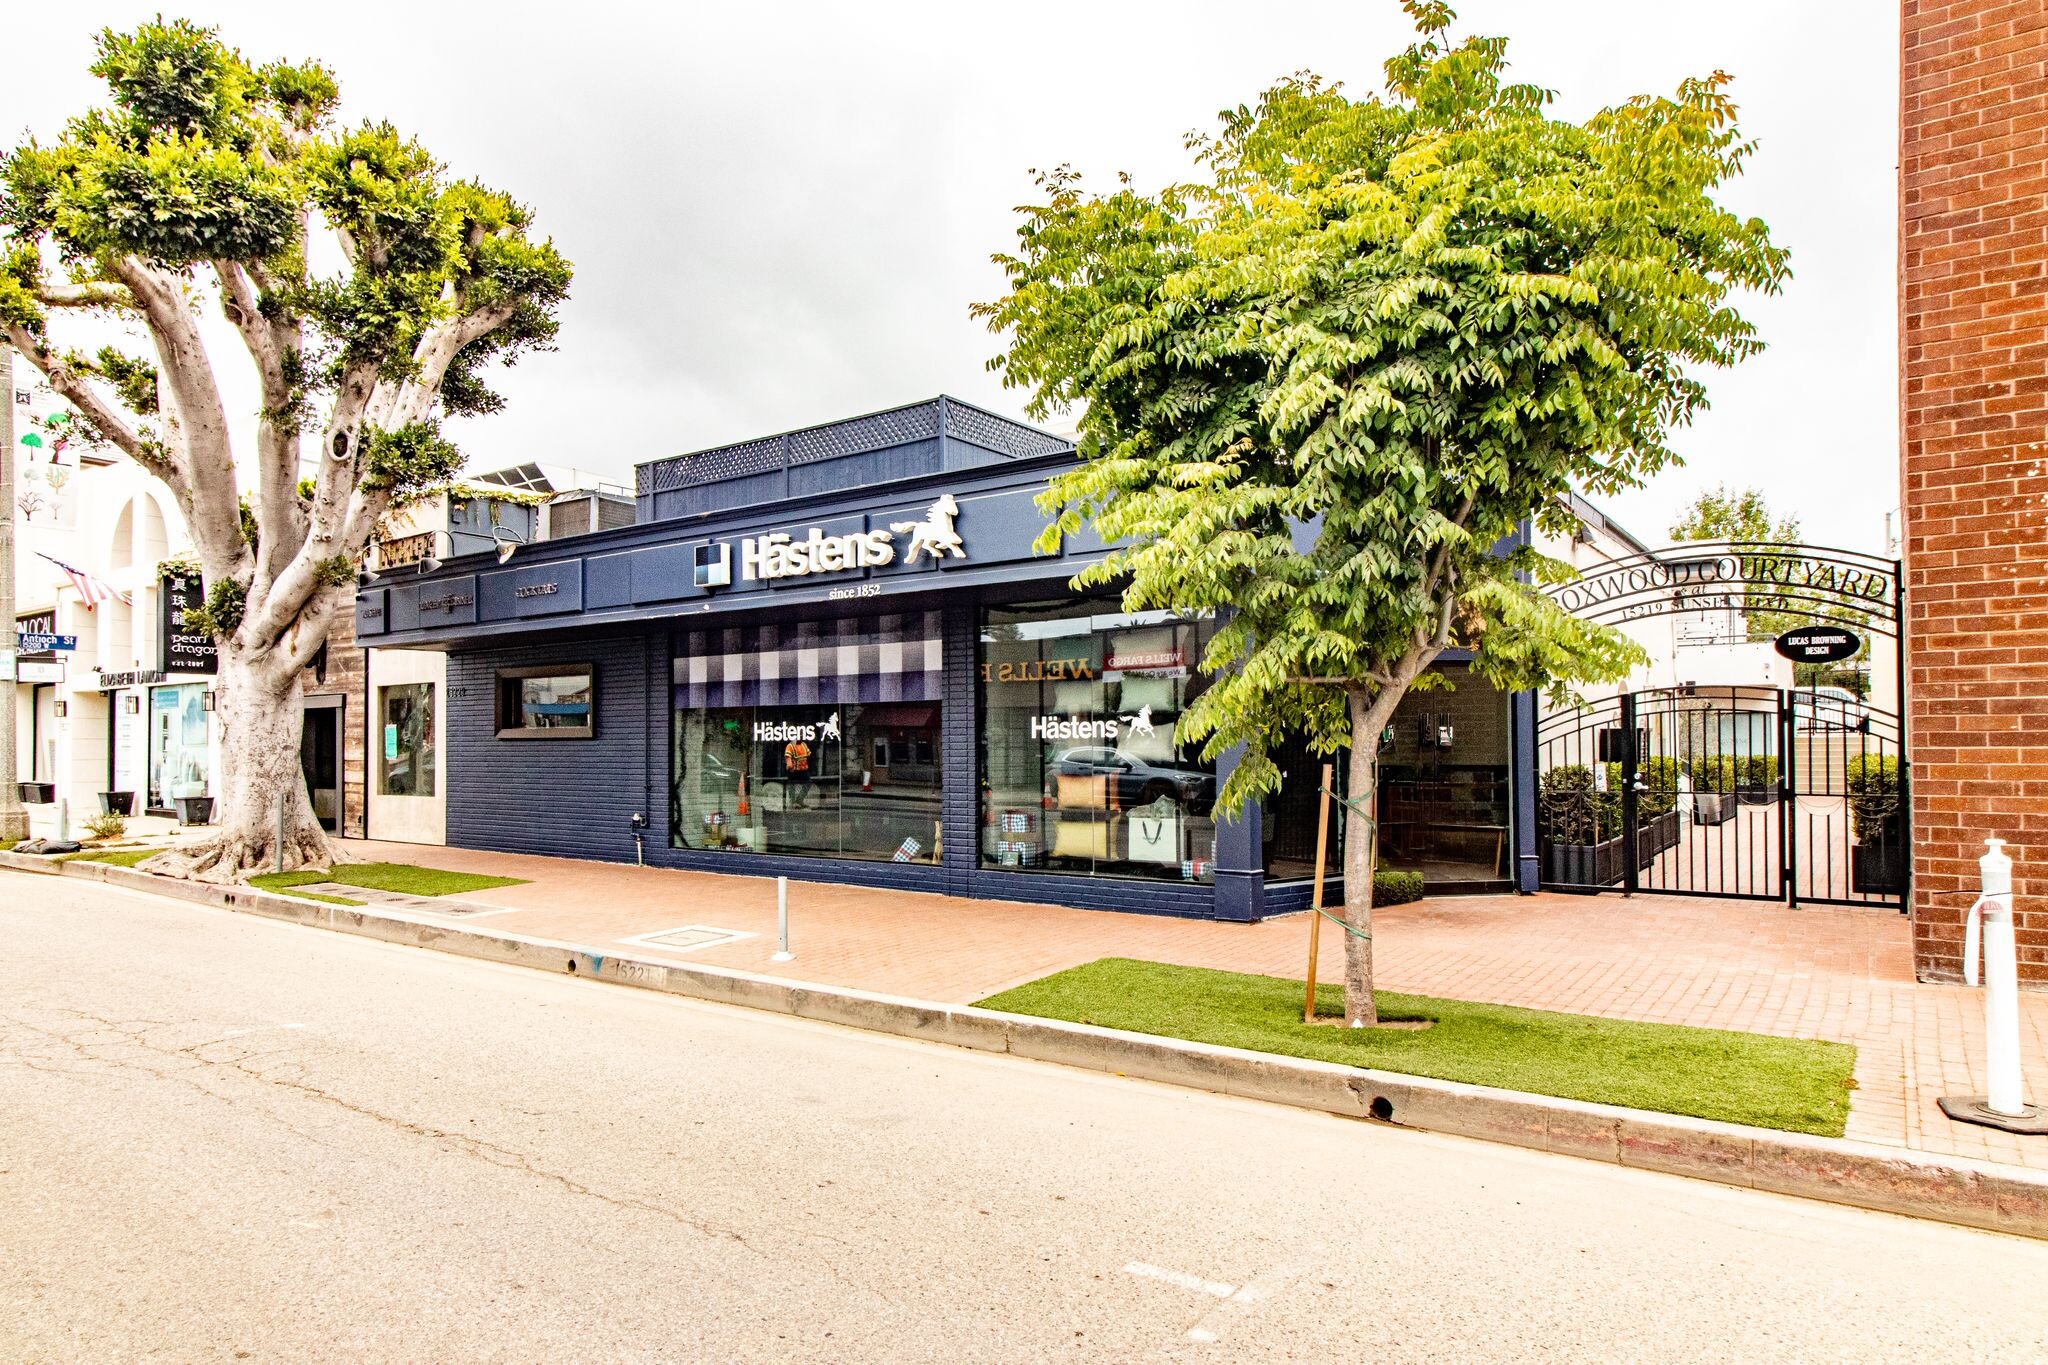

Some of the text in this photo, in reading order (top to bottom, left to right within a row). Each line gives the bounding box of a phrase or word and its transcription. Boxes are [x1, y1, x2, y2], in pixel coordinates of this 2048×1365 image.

[742, 528, 893, 581] Hästens
[1698, 557, 1889, 599] COURTYARD
[829, 584, 881, 600] since 1852
[1622, 602, 1663, 619] 15219
[1672, 596, 1737, 611] SUNSET
[22, 634, 74, 645] Antioch St
[1788, 636, 1847, 645] LUCAS BROWNING
[171, 643, 218, 656] dragon
[1805, 647, 1830, 655] DESIGN
[753, 721, 816, 742] Hästens
[1031, 716, 1119, 739] Hästens
